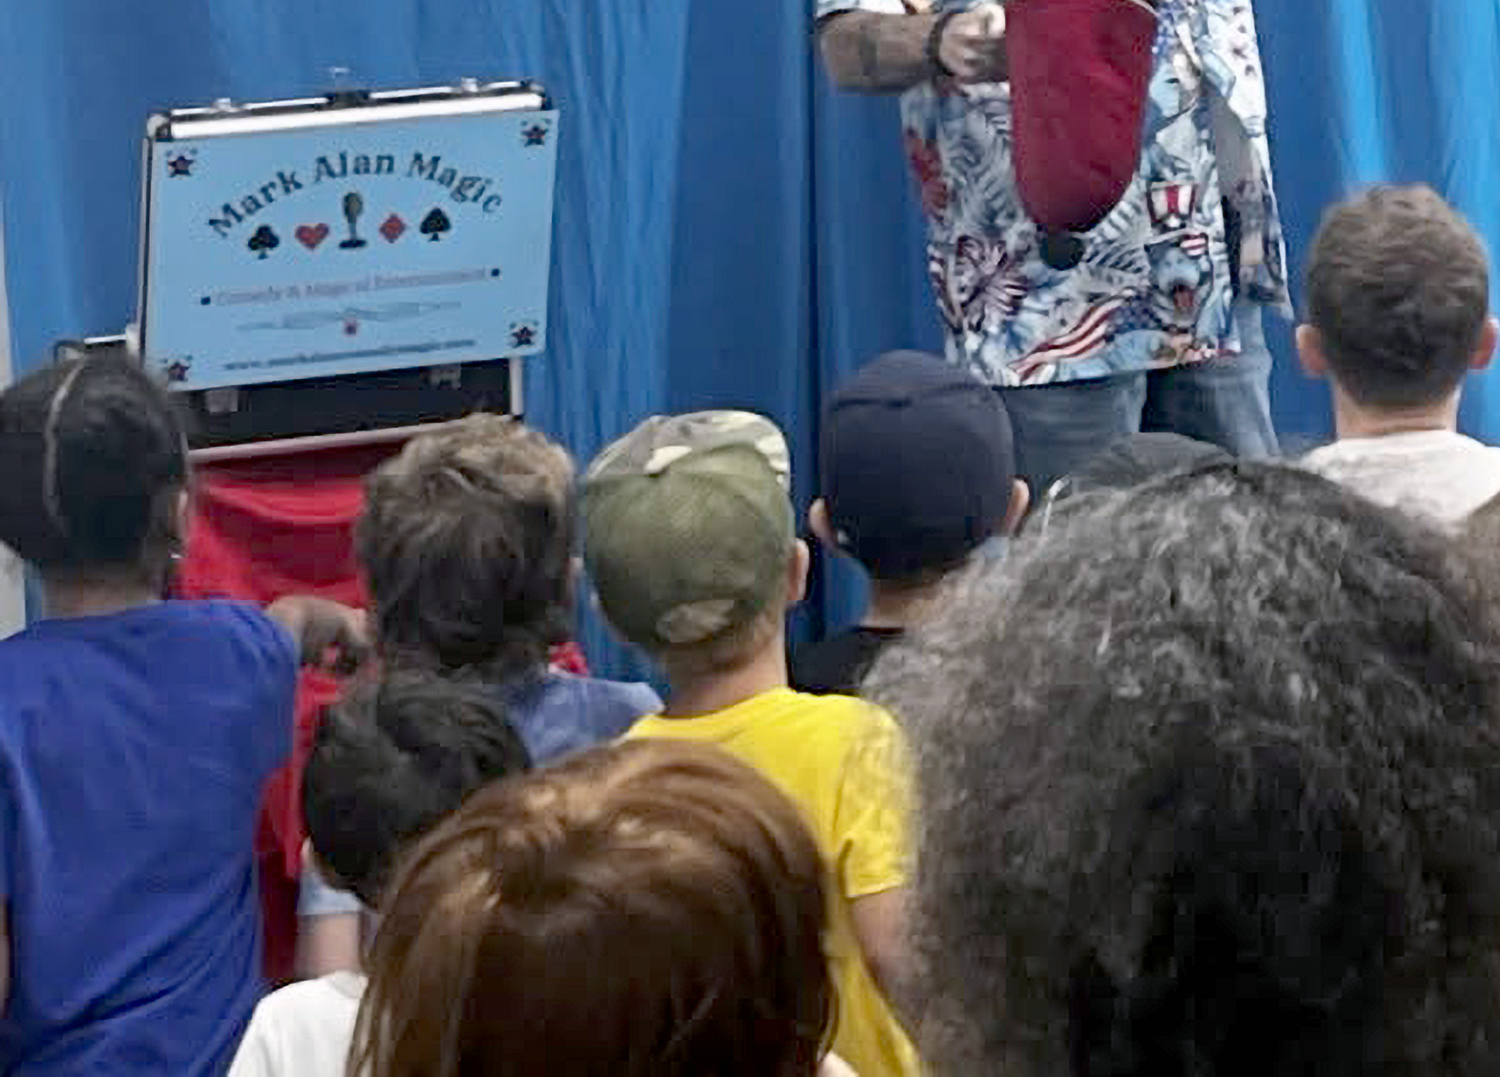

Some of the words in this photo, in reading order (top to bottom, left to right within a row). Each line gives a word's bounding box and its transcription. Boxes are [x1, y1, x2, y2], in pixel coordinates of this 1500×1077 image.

[208, 170, 303, 238] Mark
[314, 150, 395, 184] Alan
[407, 151, 502, 213] Magic
